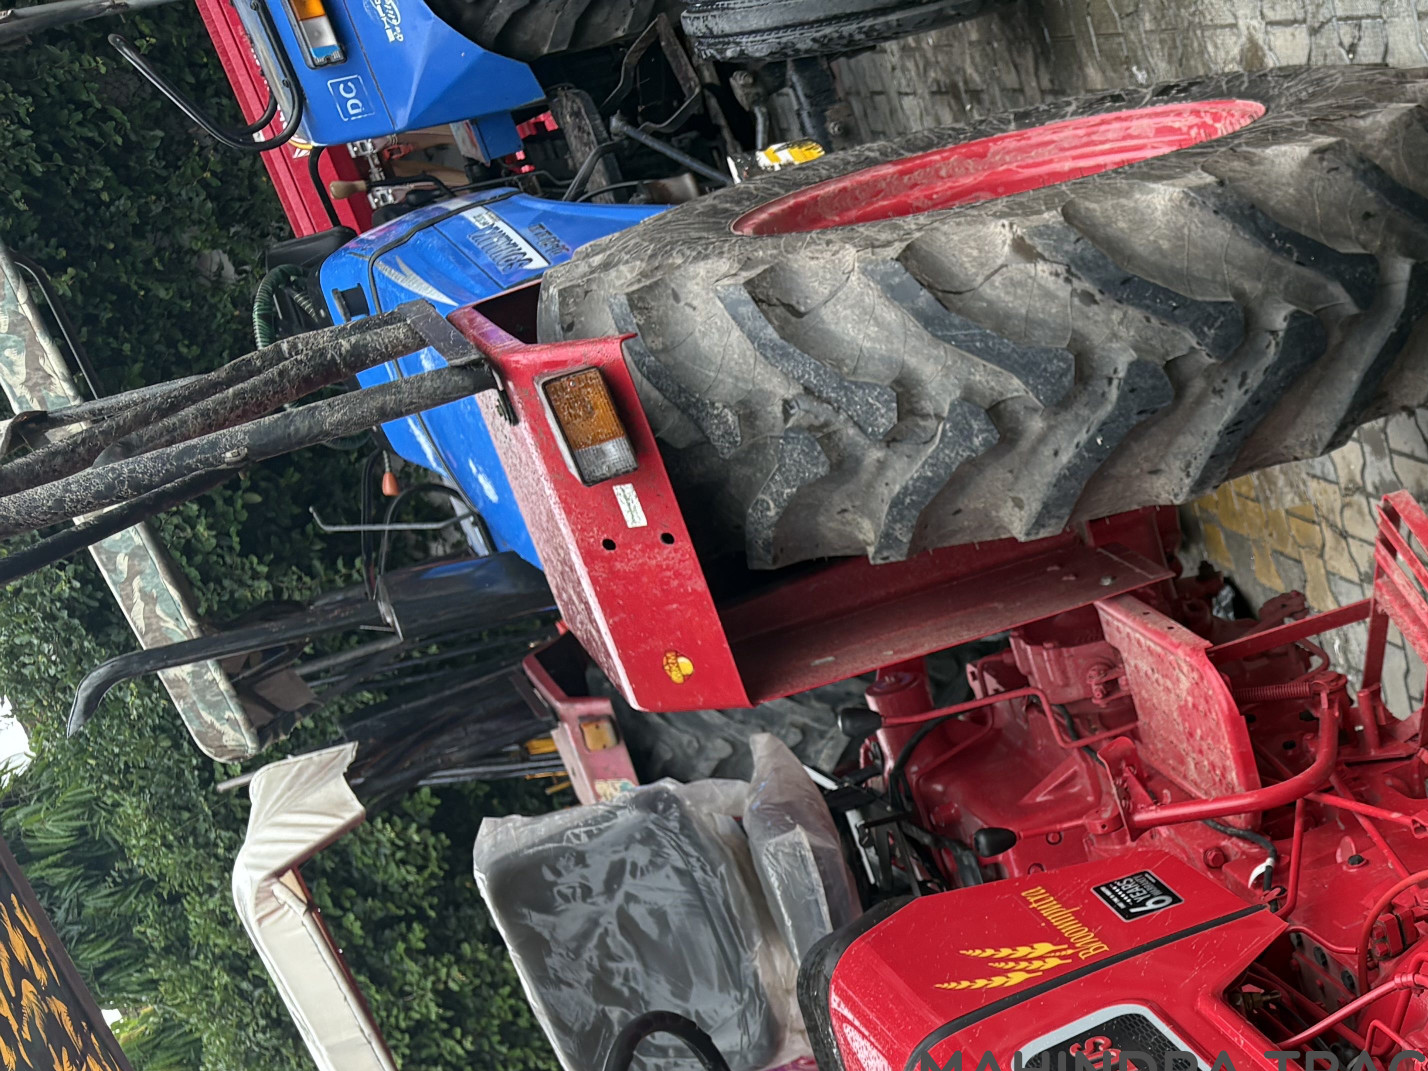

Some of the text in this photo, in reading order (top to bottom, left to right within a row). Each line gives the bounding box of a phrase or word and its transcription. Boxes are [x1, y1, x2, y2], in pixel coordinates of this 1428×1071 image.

[338, 80, 364, 116] DC
[1114, 877, 1150, 903] YEARS
[1129, 894, 1172, 913] 6
